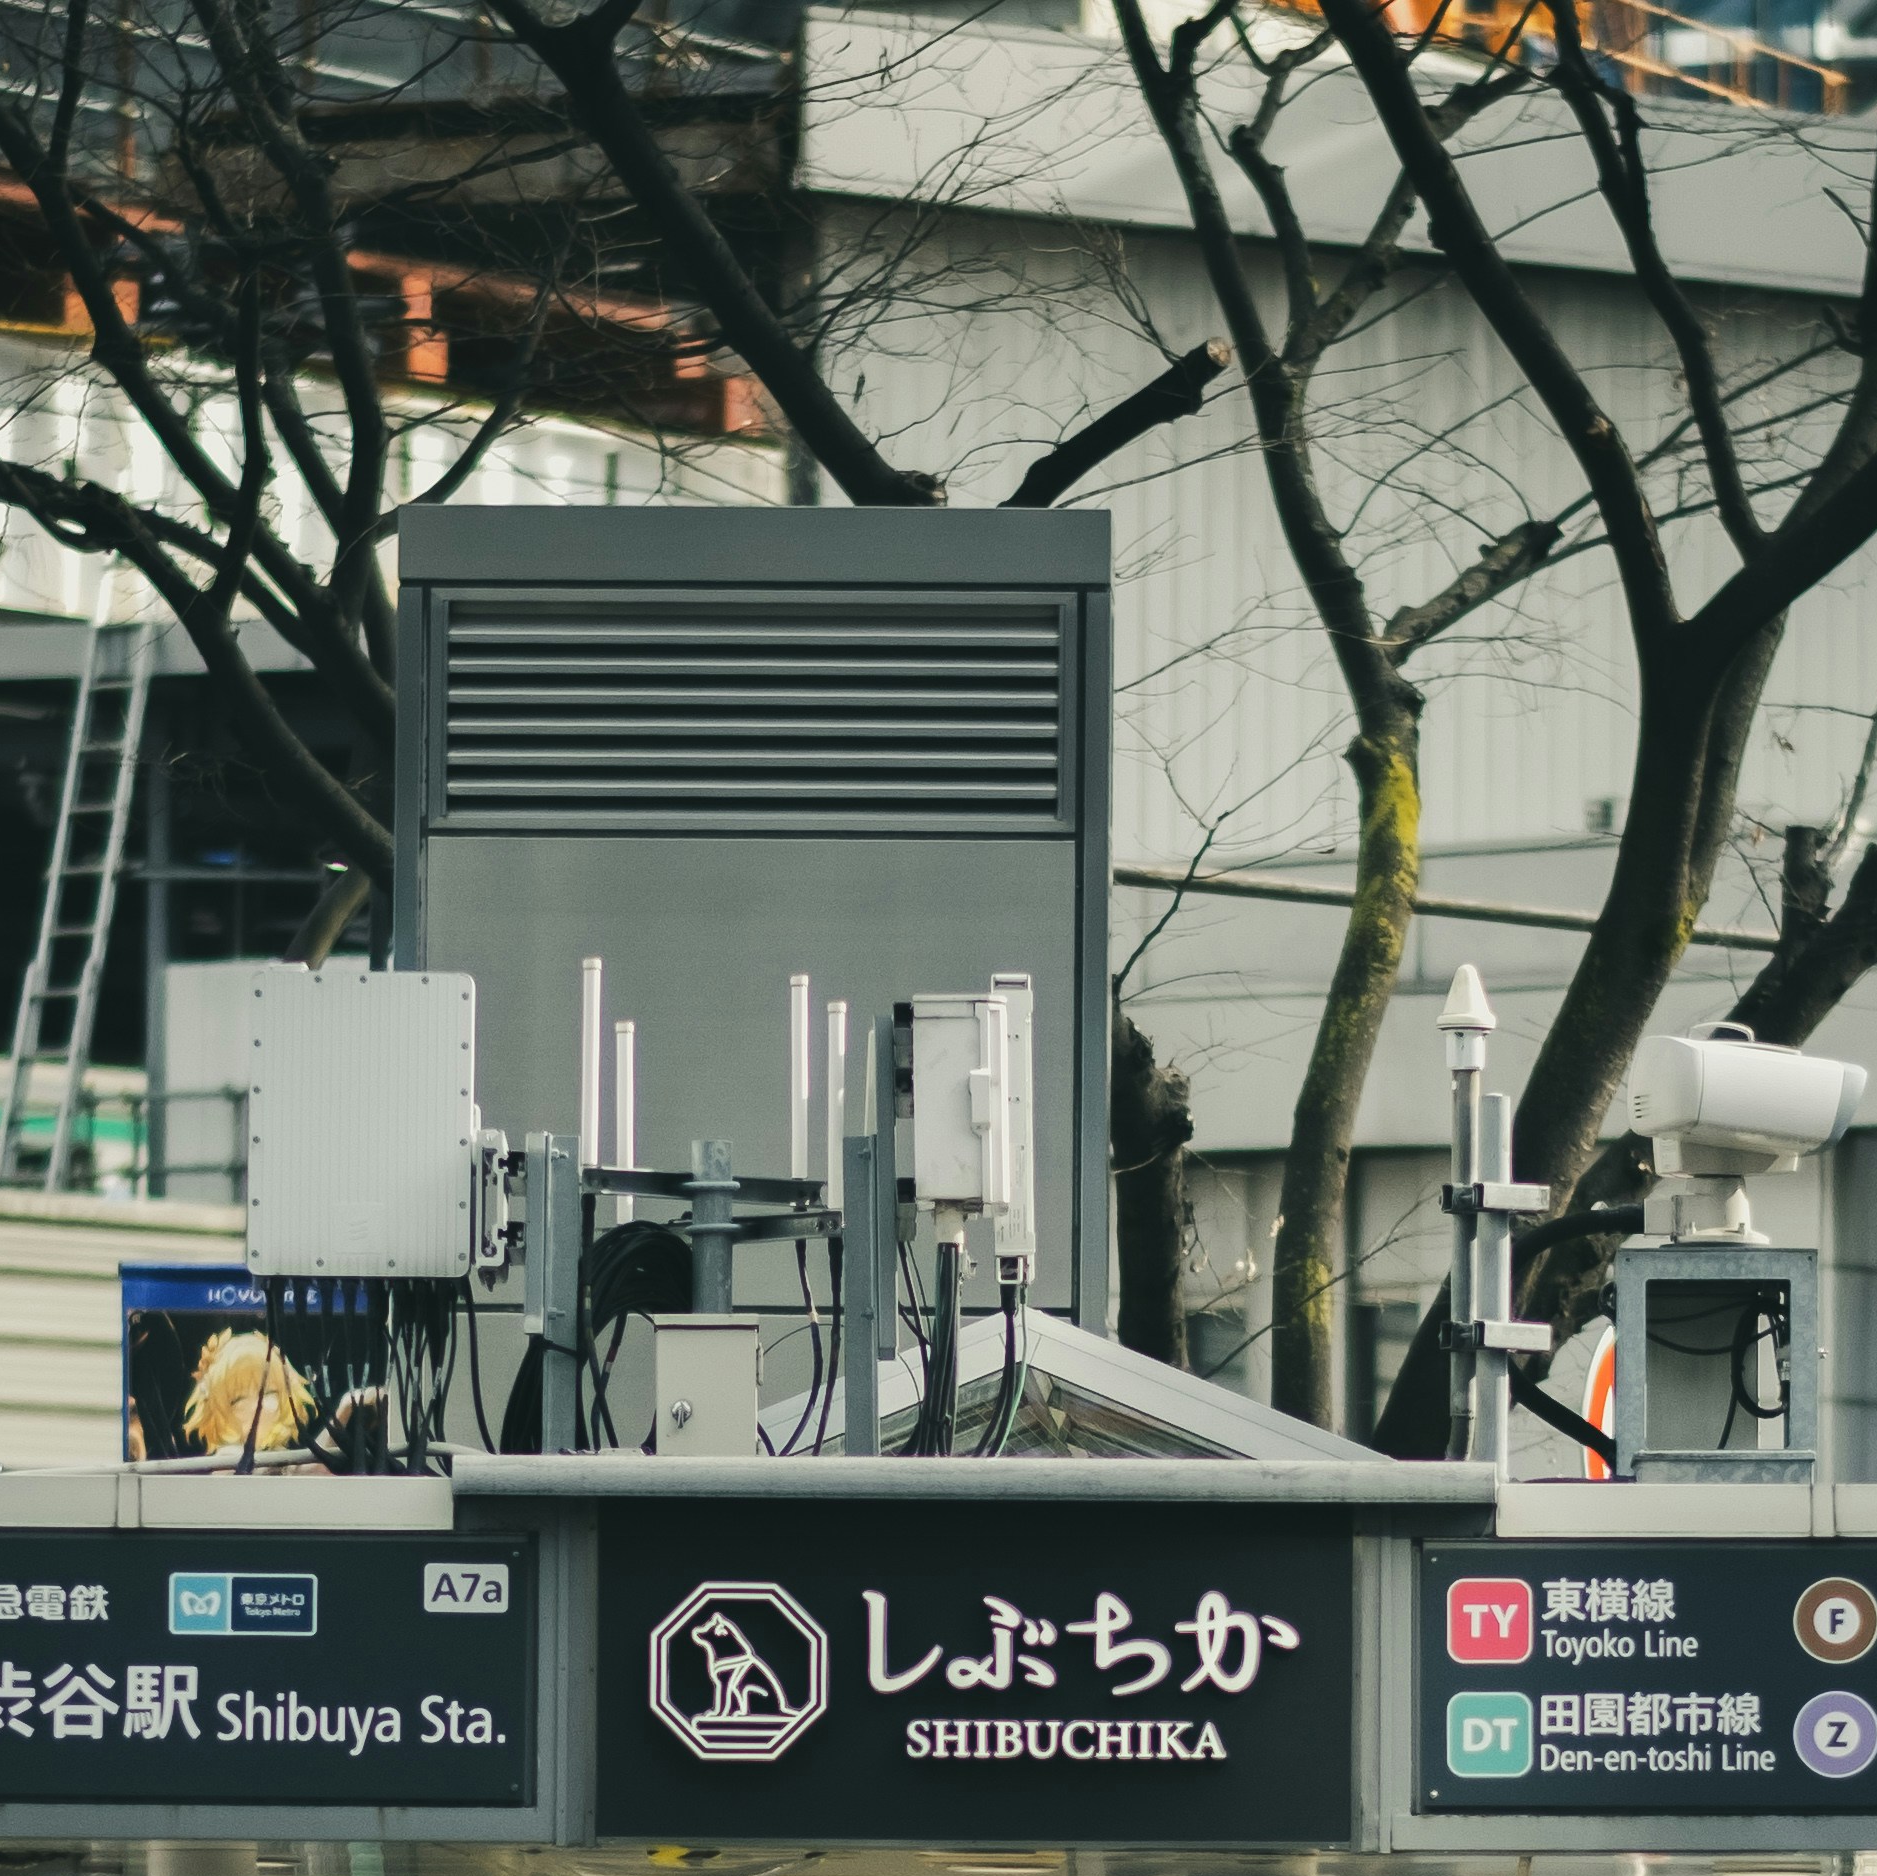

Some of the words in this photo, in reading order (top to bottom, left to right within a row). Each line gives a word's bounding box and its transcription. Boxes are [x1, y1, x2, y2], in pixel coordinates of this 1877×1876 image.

[431, 1572, 502, 1603] A7a
[1541, 1577, 1675, 1622] 東横線
[1463, 1604, 1518, 1638] TY
[1829, 1608, 1845, 1635] F
[862, 1590, 1300, 1696] しぶちか
[1541, 1630, 1635, 1666] Toyoko
[1645, 1629, 1698, 1658] Line
[217, 1690, 401, 1757] Shibuya
[420, 1694, 506, 1744] Sta.
[1540, 1691, 1762, 1737] 田園都市線
[906, 1719, 1227, 1760] SHIBUCHIKA
[1463, 1717, 1518, 1752] DT
[1826, 1721, 1848, 1748] Z
[1540, 1743, 1711, 1772] Den-en-toshi
[1721, 1743, 1776, 1772] Line
